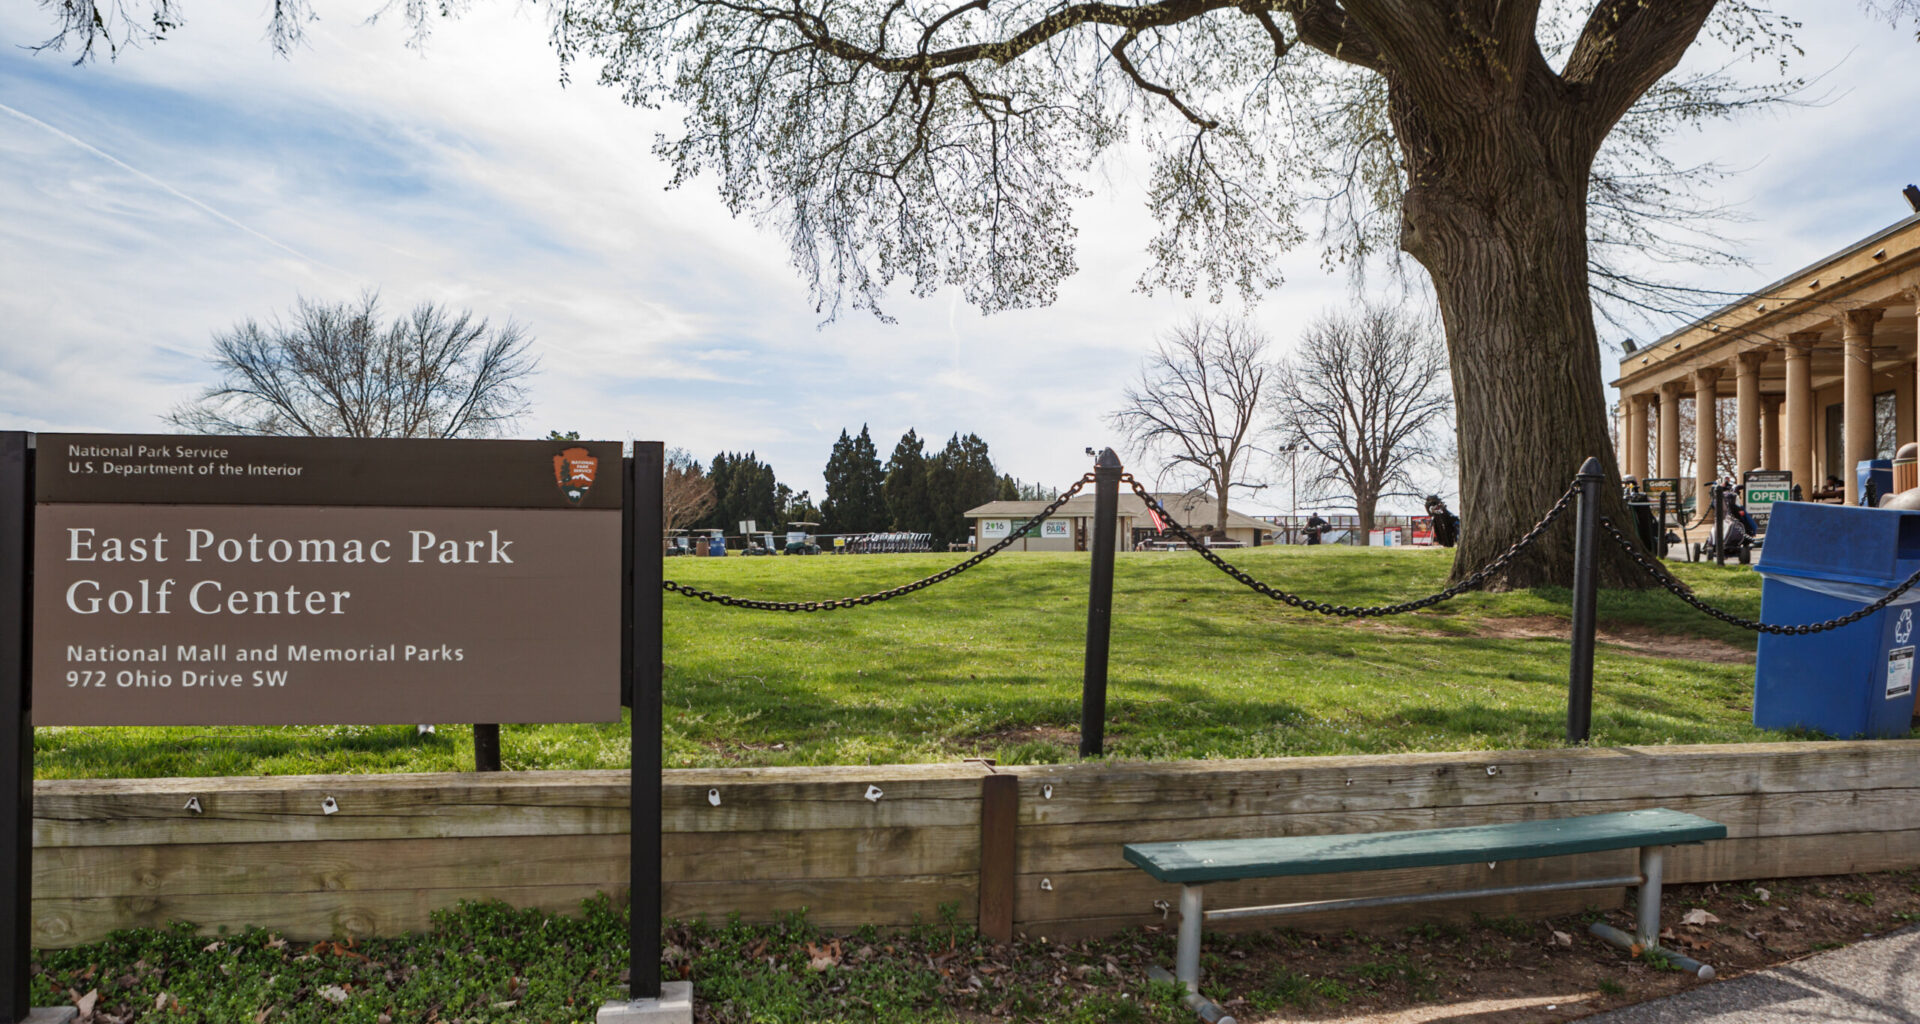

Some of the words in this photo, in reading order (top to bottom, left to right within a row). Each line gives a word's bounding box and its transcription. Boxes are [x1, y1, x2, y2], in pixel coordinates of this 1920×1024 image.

[68, 444, 133, 457] National
[138, 445, 171, 458] Park
[175, 445, 229, 459] Service
[68, 461, 97, 474] U.S.
[103, 461, 194, 477] Department
[198, 462, 215, 475] of
[219, 463, 244, 476] the
[247, 463, 303, 476] Interior
[1752, 491, 1785, 501] OPEN
[66, 527, 169, 563] East
[185, 528, 391, 564] Potomac
[407, 529, 514, 564] Park
[66, 578, 176, 615] Golf
[189, 580, 351, 615] Center
[67, 644, 167, 662] National
[177, 644, 226, 662] Mall
[235, 644, 278, 662] and
[287, 644, 395, 662] Memorial
[404, 643, 464, 662] Parks
[66, 670, 107, 688] 972
[116, 669, 172, 688] Ohio
[182, 669, 243, 687] Drive
[252, 670, 288, 687] SW
